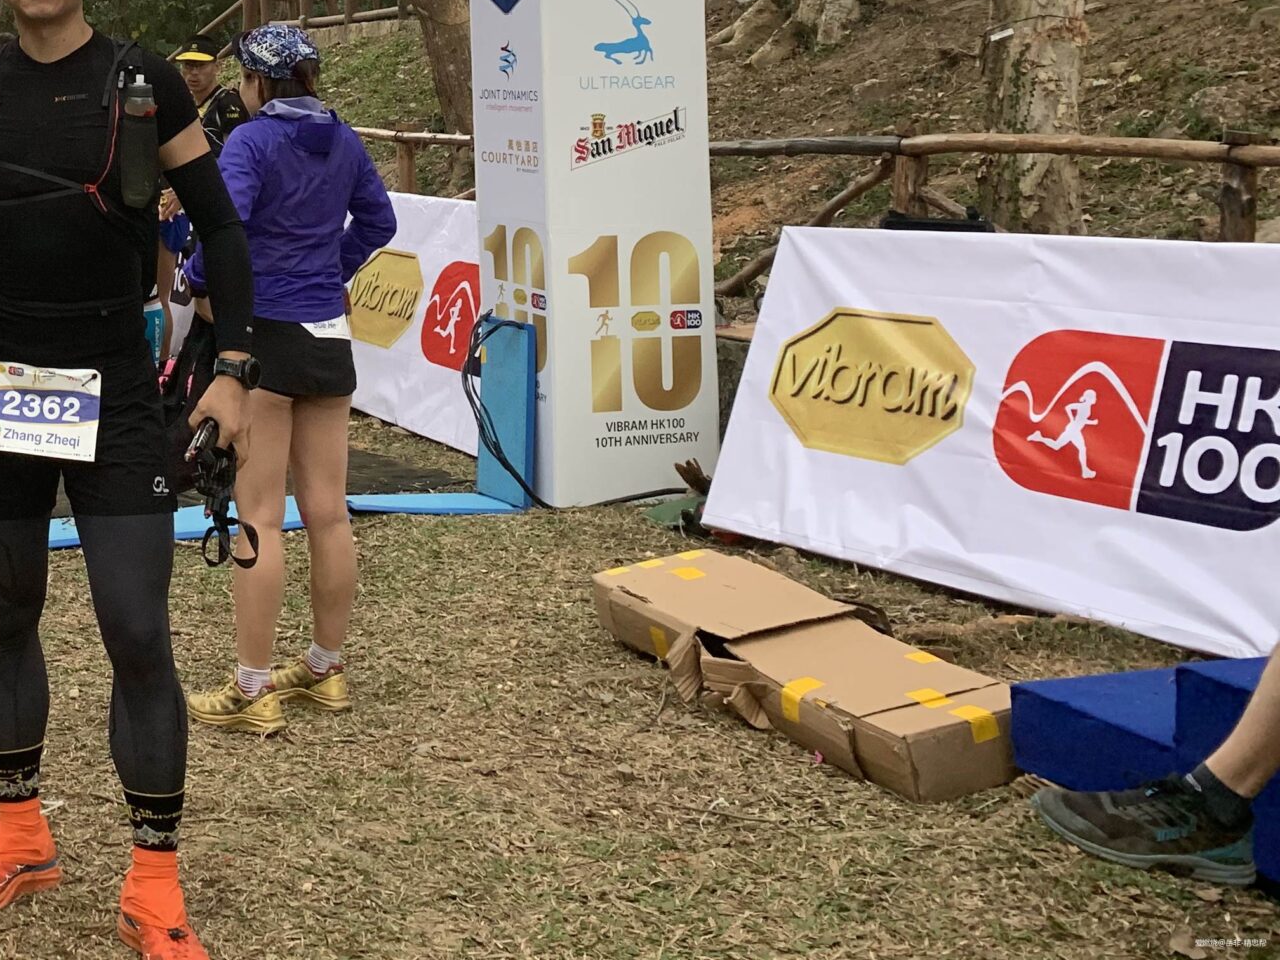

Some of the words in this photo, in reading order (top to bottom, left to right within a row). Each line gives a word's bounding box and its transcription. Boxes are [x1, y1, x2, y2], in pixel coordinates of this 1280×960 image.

[579, 75, 676, 90] ULTRAGEAR
[480, 89, 500, 100] JOINT
[503, 90, 538, 102] DYNAMICS
[575, 137, 614, 164] San
[616, 107, 684, 152] Miguel
[481, 151, 539, 168] COURTYARD
[568, 230, 703, 413] 10
[687, 319, 701, 327] 100
[1, 390, 81, 423] 2362
[606, 419, 648, 433] VIBRAM
[651, 418, 685, 431] HK100
[3, 427, 42, 446] Zhang
[45, 432, 81, 450] Zheqi
[595, 435, 622, 448] 10TH
[625, 431, 700, 447] ANNIVERSARY
